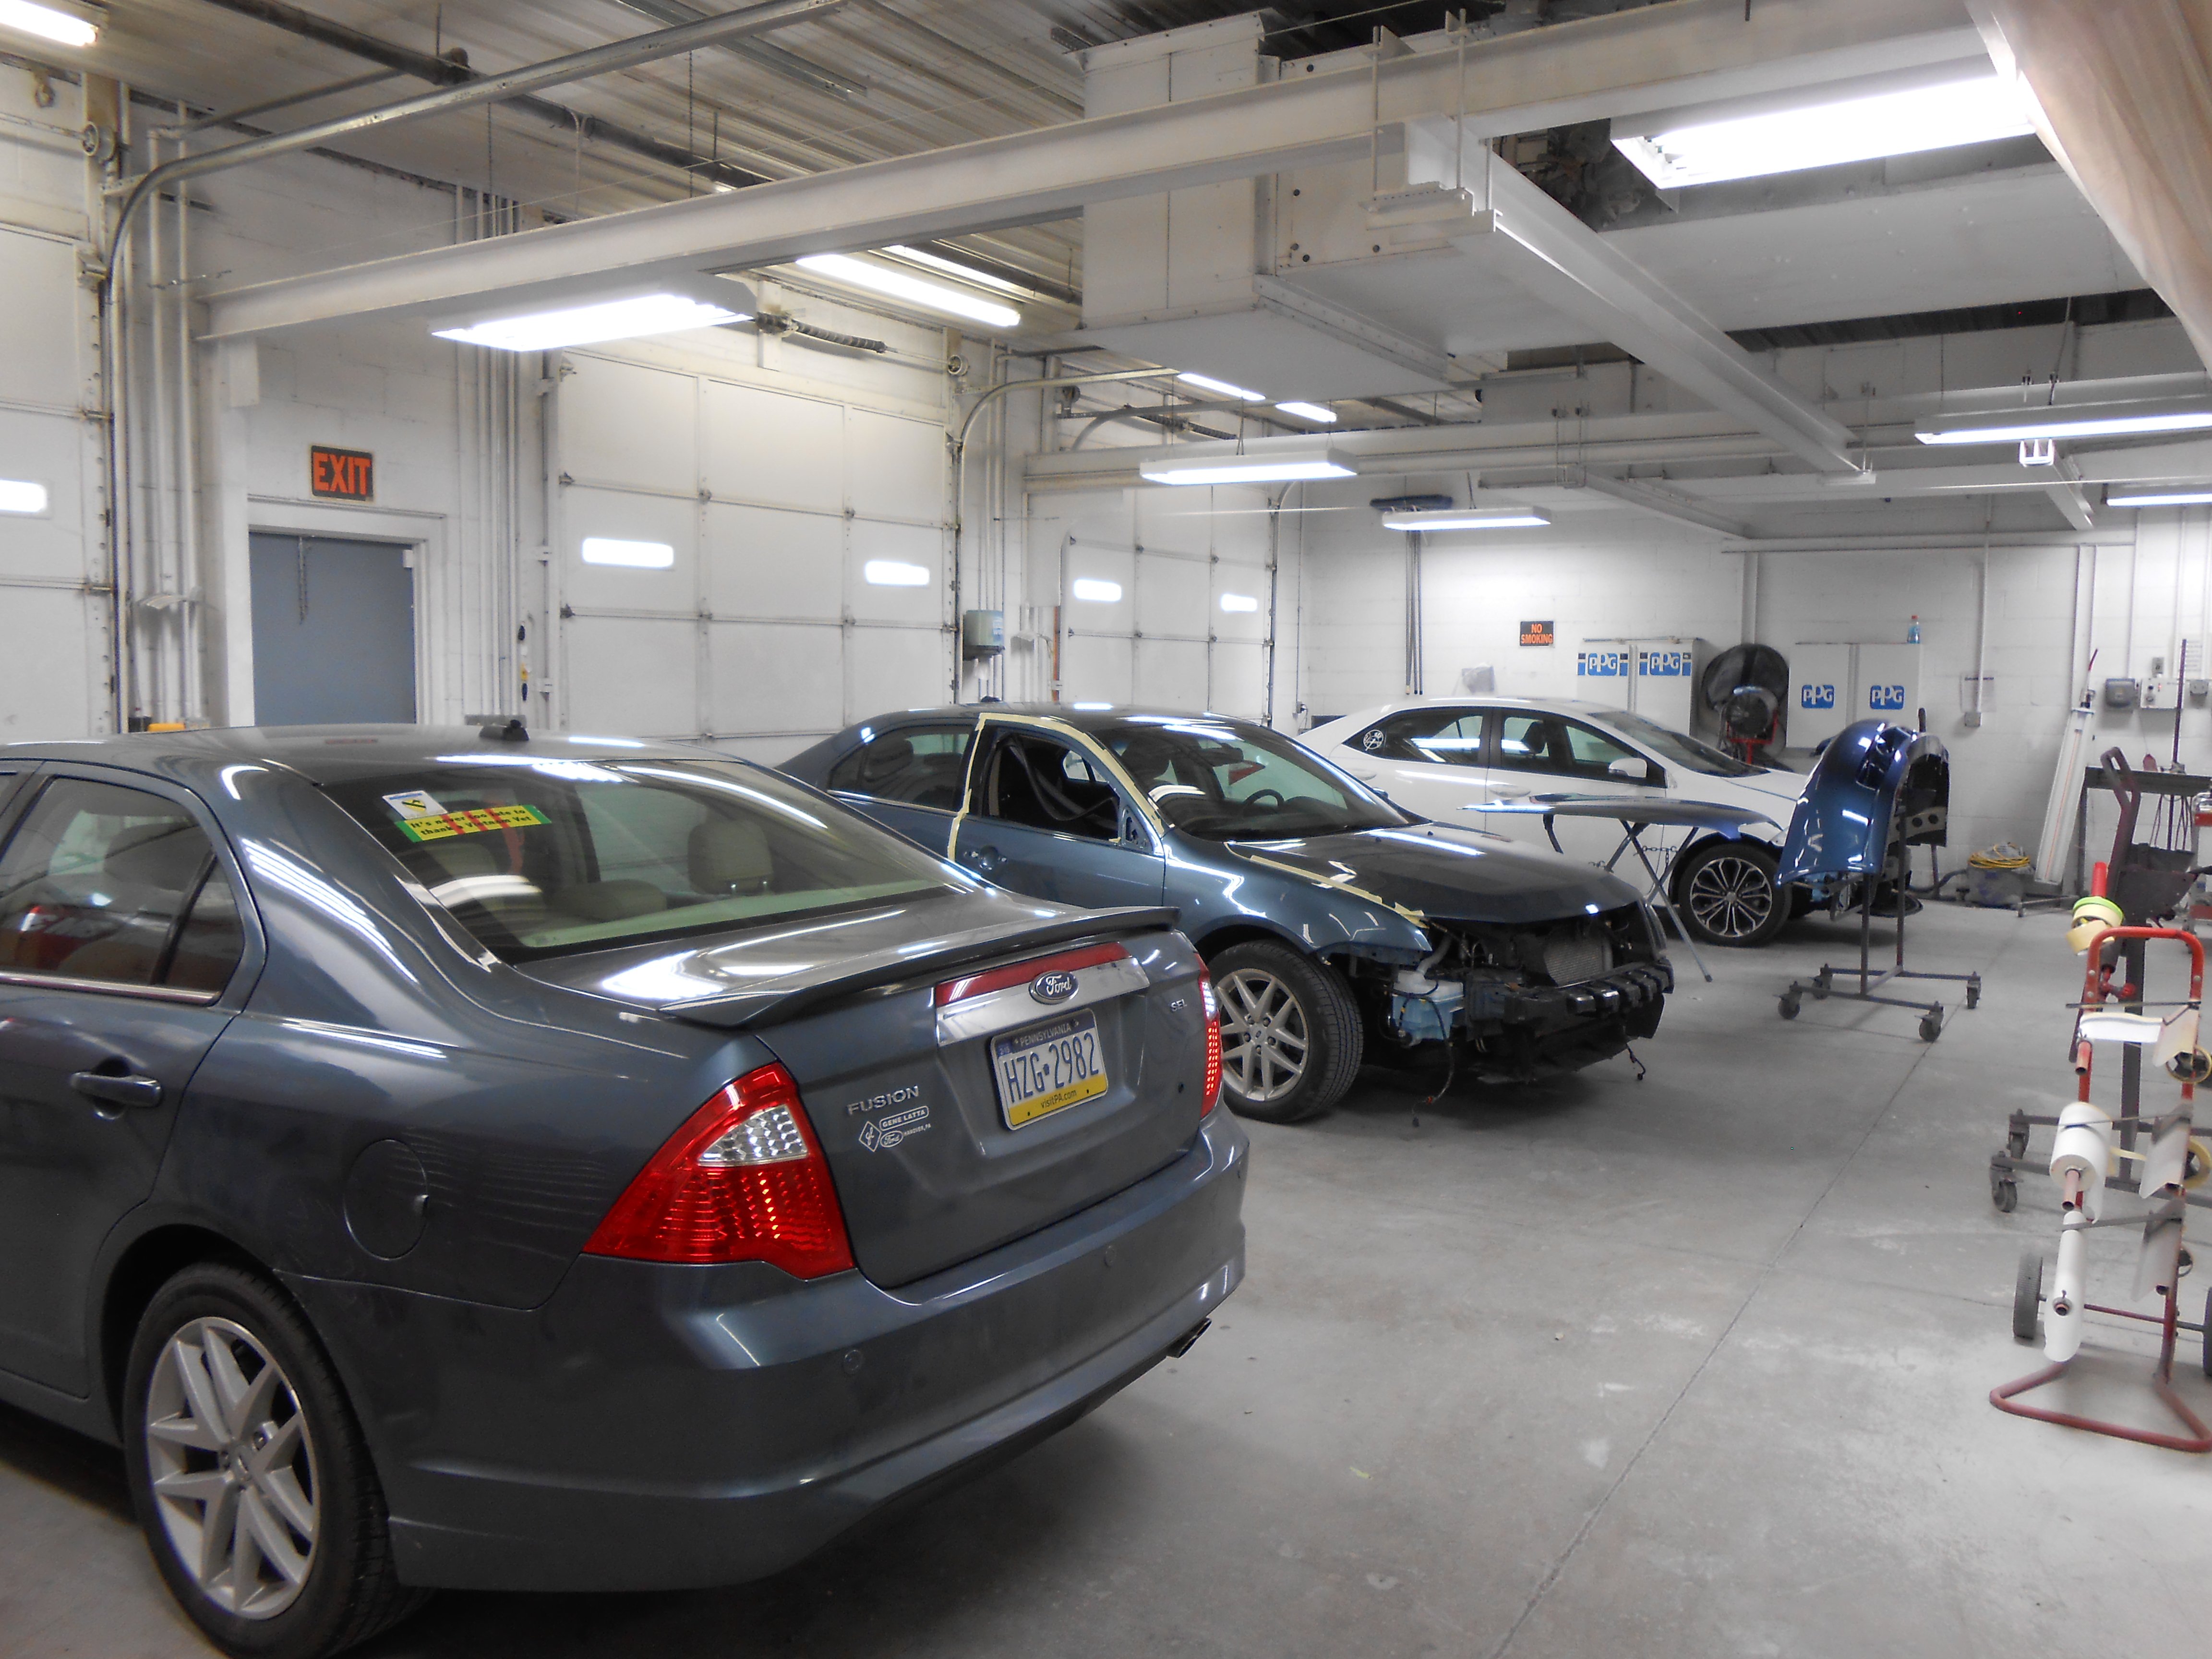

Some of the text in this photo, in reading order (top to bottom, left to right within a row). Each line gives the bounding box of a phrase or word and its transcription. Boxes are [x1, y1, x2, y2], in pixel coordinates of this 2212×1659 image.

[313, 452, 371, 495] EXIT
[1530, 624, 1543, 633] NO
[1521, 633, 1553, 644] SMOKING
[1589, 652, 1617, 672] PPG
[1651, 652, 1680, 672] PPG
[1803, 684, 1833, 705] PPG
[1872, 685, 1903, 706] PPG
[435, 816, 466, 825] never
[421, 827, 455, 836] thank
[1046, 974, 1071, 996] Ford
[1170, 999, 1188, 1012] SEL
[1020, 1022, 1072, 1047] PENNSYLVANIA
[846, 1085, 919, 1115] FUSION
[1041, 1090, 1077, 1108] visitPA.com
[882, 1109, 926, 1127] GENE LATTA
[884, 1133, 900, 1145] Ford
